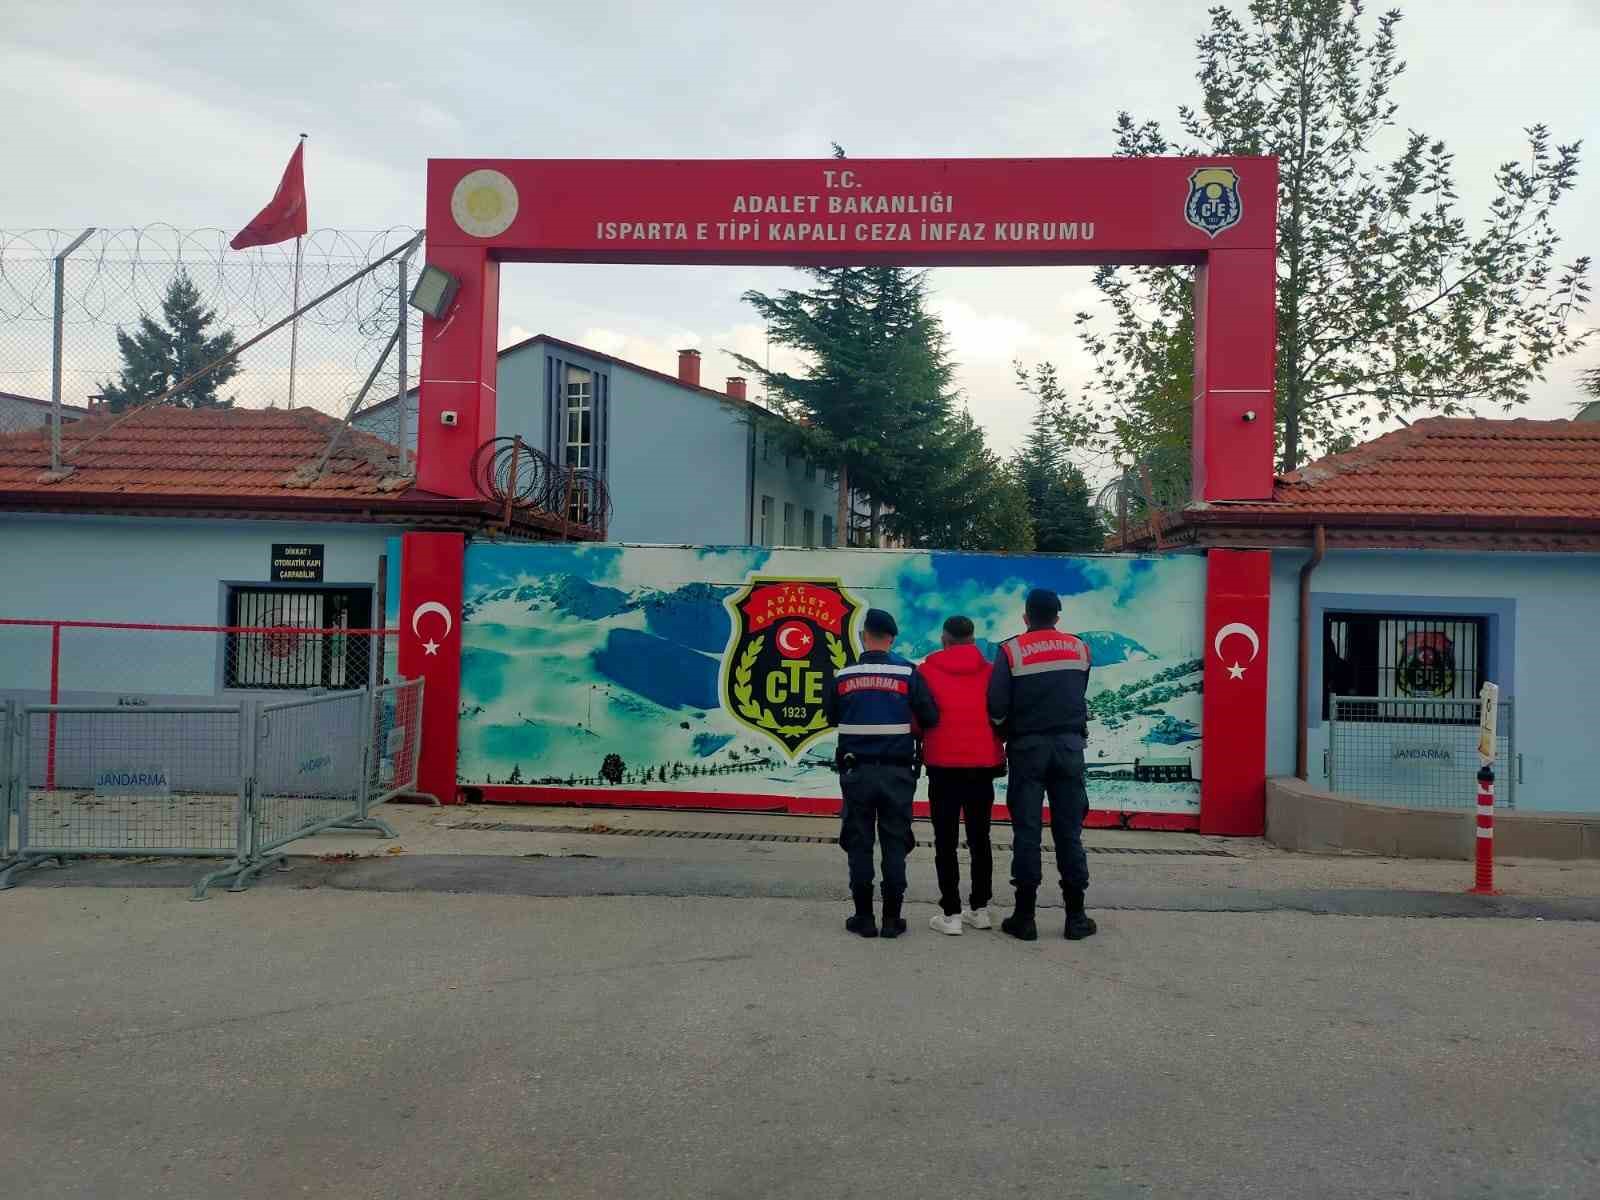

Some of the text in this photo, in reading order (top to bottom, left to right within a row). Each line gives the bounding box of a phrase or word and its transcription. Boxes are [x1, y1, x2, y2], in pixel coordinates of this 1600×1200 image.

[823, 170, 863, 189] T.C.
[733, 191, 954, 214] ADALET BAKANLIĞI
[1201, 199, 1226, 217] CTE
[596, 218, 1095, 242] ISPARTA E TİPİ KAPALI CEZA İNFAZ KURUMU
[274, 558, 321, 568] OTOMATİK KAPI
[767, 595, 827, 608] ADALET
[766, 659, 824, 704] CTE
[845, 676, 898, 692] JANDARMA
[781, 706, 808, 719] 1923
[1394, 749, 1450, 760] JANDARMA
[97, 773, 168, 786] JANDARMA
